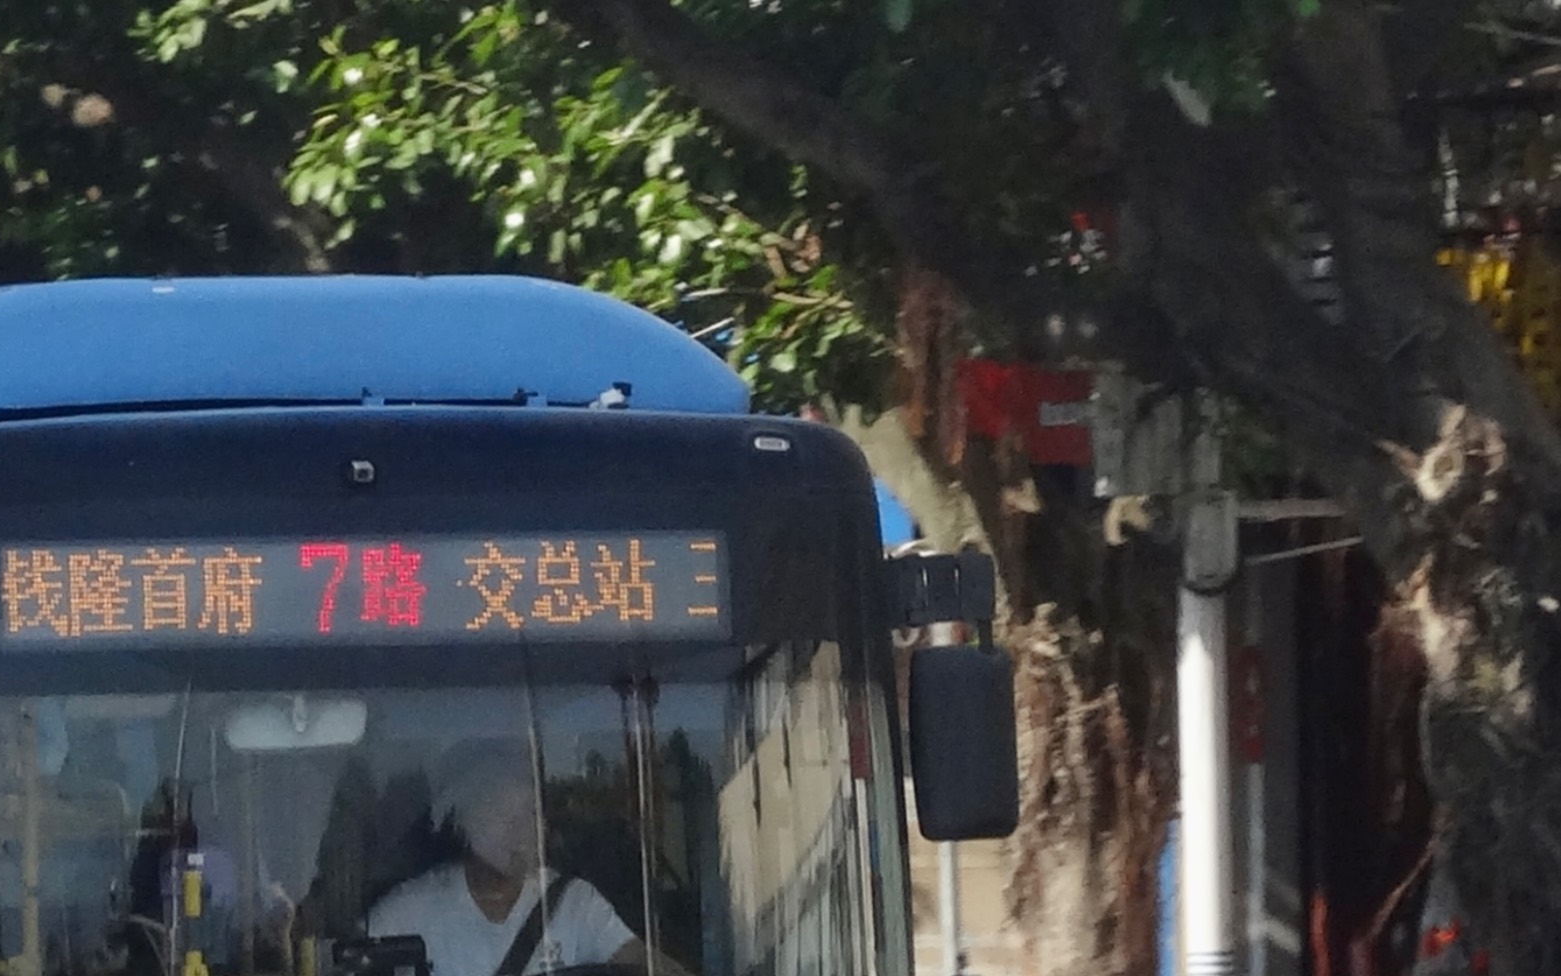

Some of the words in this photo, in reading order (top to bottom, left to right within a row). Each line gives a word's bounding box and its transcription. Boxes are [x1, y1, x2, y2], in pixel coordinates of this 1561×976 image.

[300, 543, 428, 633] 7路
[463, 539, 656, 632] 交总站
